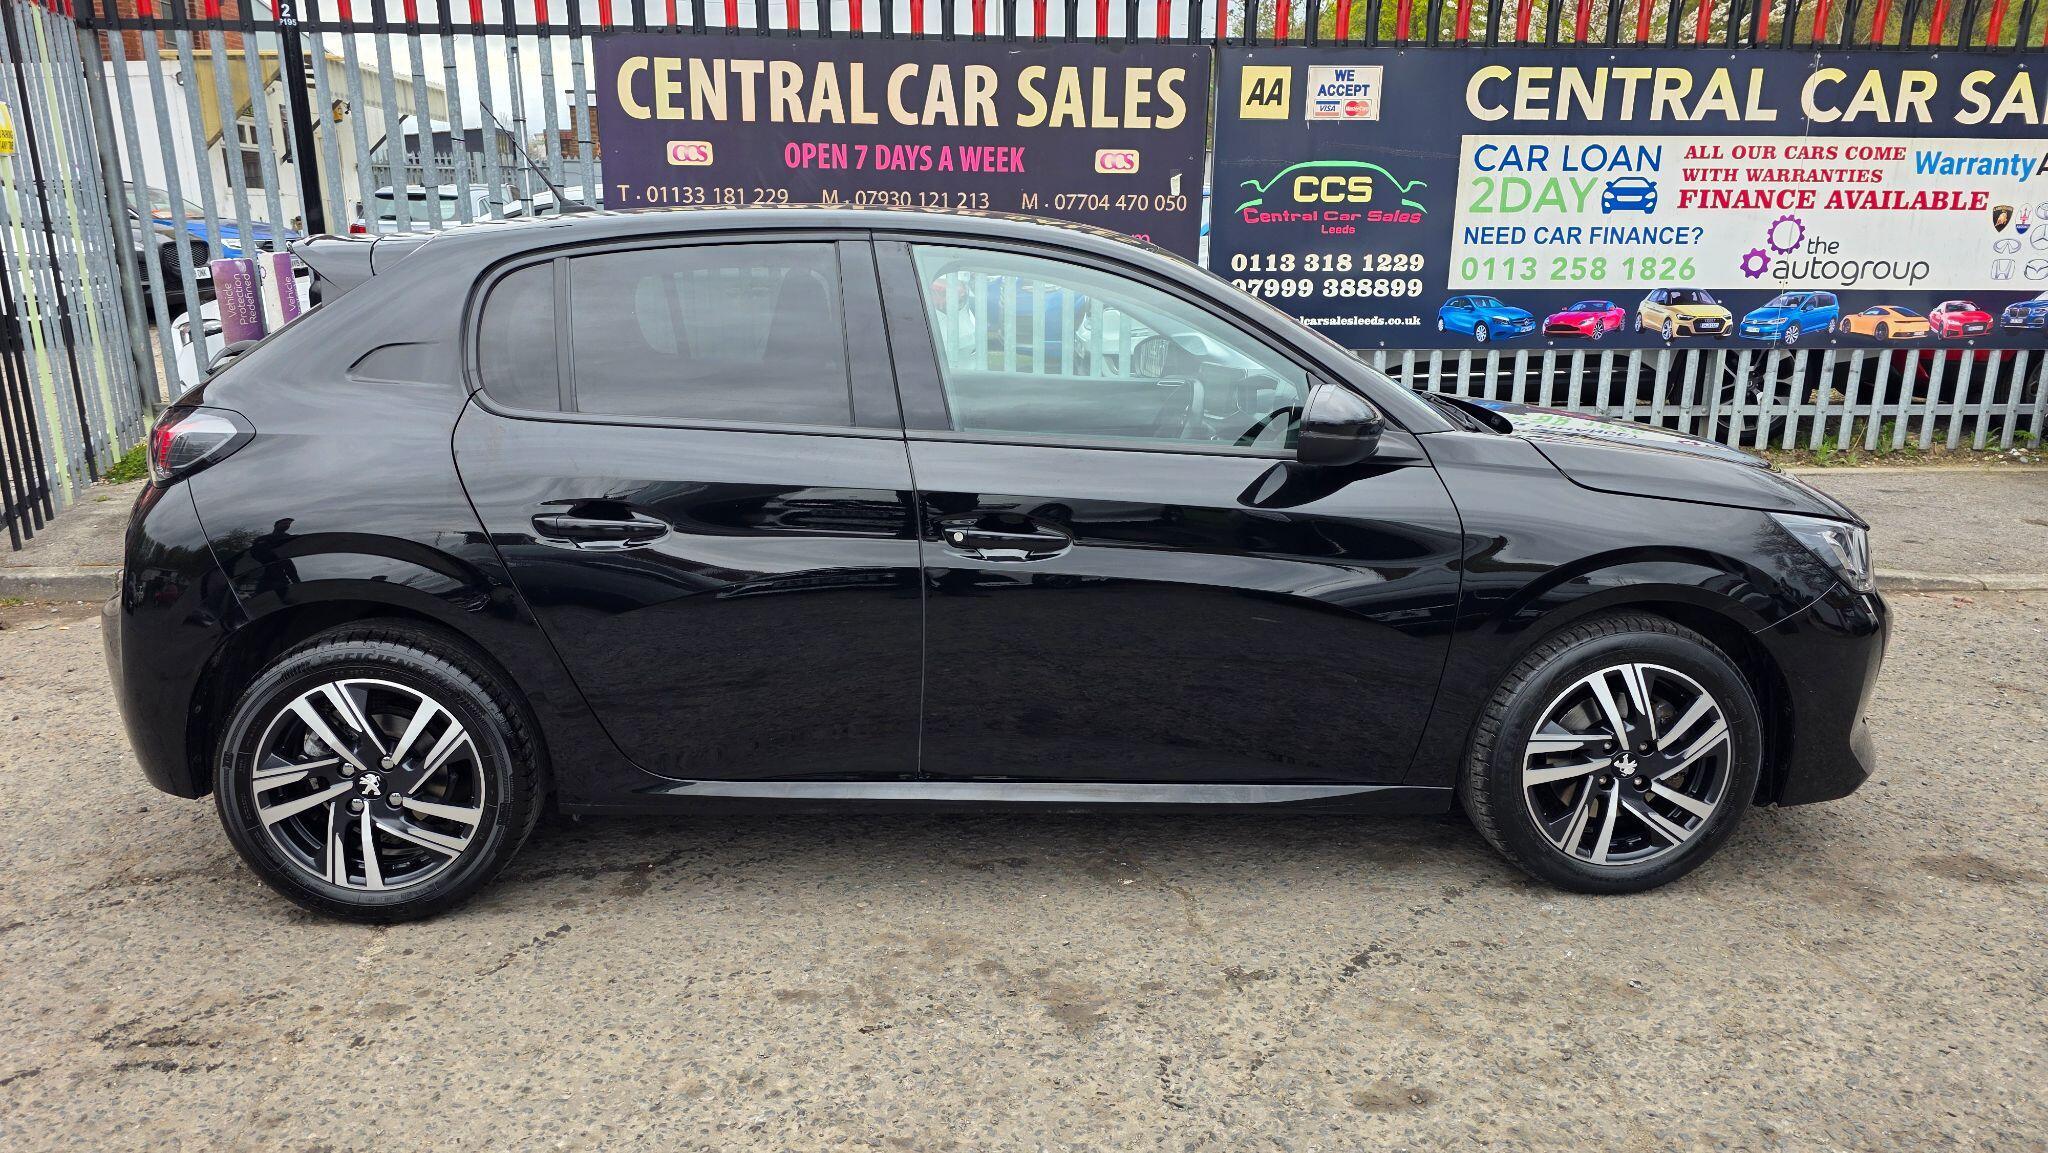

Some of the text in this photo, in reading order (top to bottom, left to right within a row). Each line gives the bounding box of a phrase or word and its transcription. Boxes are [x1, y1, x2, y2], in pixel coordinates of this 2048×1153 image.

[281, 4, 291, 17] 2
[1335, 69, 1355, 82] WE
[617, 56, 1187, 129] CENTRAL CAR SALES
[1246, 77, 1284, 106] AA
[1317, 84, 1370, 97] ACCEPT
[1466, 65, 2048, 125] CENTRAL CAR SA
[672, 145, 708, 162] CCS
[784, 142, 1025, 172] OPEN 7 DAYS A WEEK
[1100, 153, 1134, 170] CCS
[1474, 144, 1662, 172] CAR LOAN
[1684, 145, 1906, 160] ALL OUR CARS COME
[1682, 168, 1883, 183] WITH WARRANTIES
[617, 184, 630, 202] T
[646, 185, 705, 204] 01133
[713, 187, 745, 205] 181
[753, 188, 789, 204] 229
[822, 189, 839, 204] M
[855, 190, 911, 207] 07930
[919, 192, 948, 208] 121
[957, 192, 989, 209] 213
[1293, 175, 1373, 203] CCS
[1468, 177, 1598, 213] 2DAY
[1021, 193, 1038, 210] M
[1054, 193, 1110, 211] 07704
[1115, 194, 1149, 211] 470
[1154, 195, 1187, 211] 050
[1677, 189, 1990, 211] FINANCE AVAILABLE
[1243, 207, 1422, 224] Central Car Sales
[1321, 224, 1355, 234] Leeds
[1464, 226, 1704, 245] NEED CAR FINANCE?
[1807, 236, 1840, 255] the
[1231, 253, 1425, 272] 0113 318 1229
[1461, 256, 1696, 281] 0113 258 1826
[1772, 257, 1930, 286] autogroup
[285, 276, 296, 312] Vehicle
[1231, 278, 1423, 298] 07999 388899
[223, 283, 237, 318] Vehicle
[233, 273, 249, 326] Protection
[241, 273, 257, 324] Redefined
